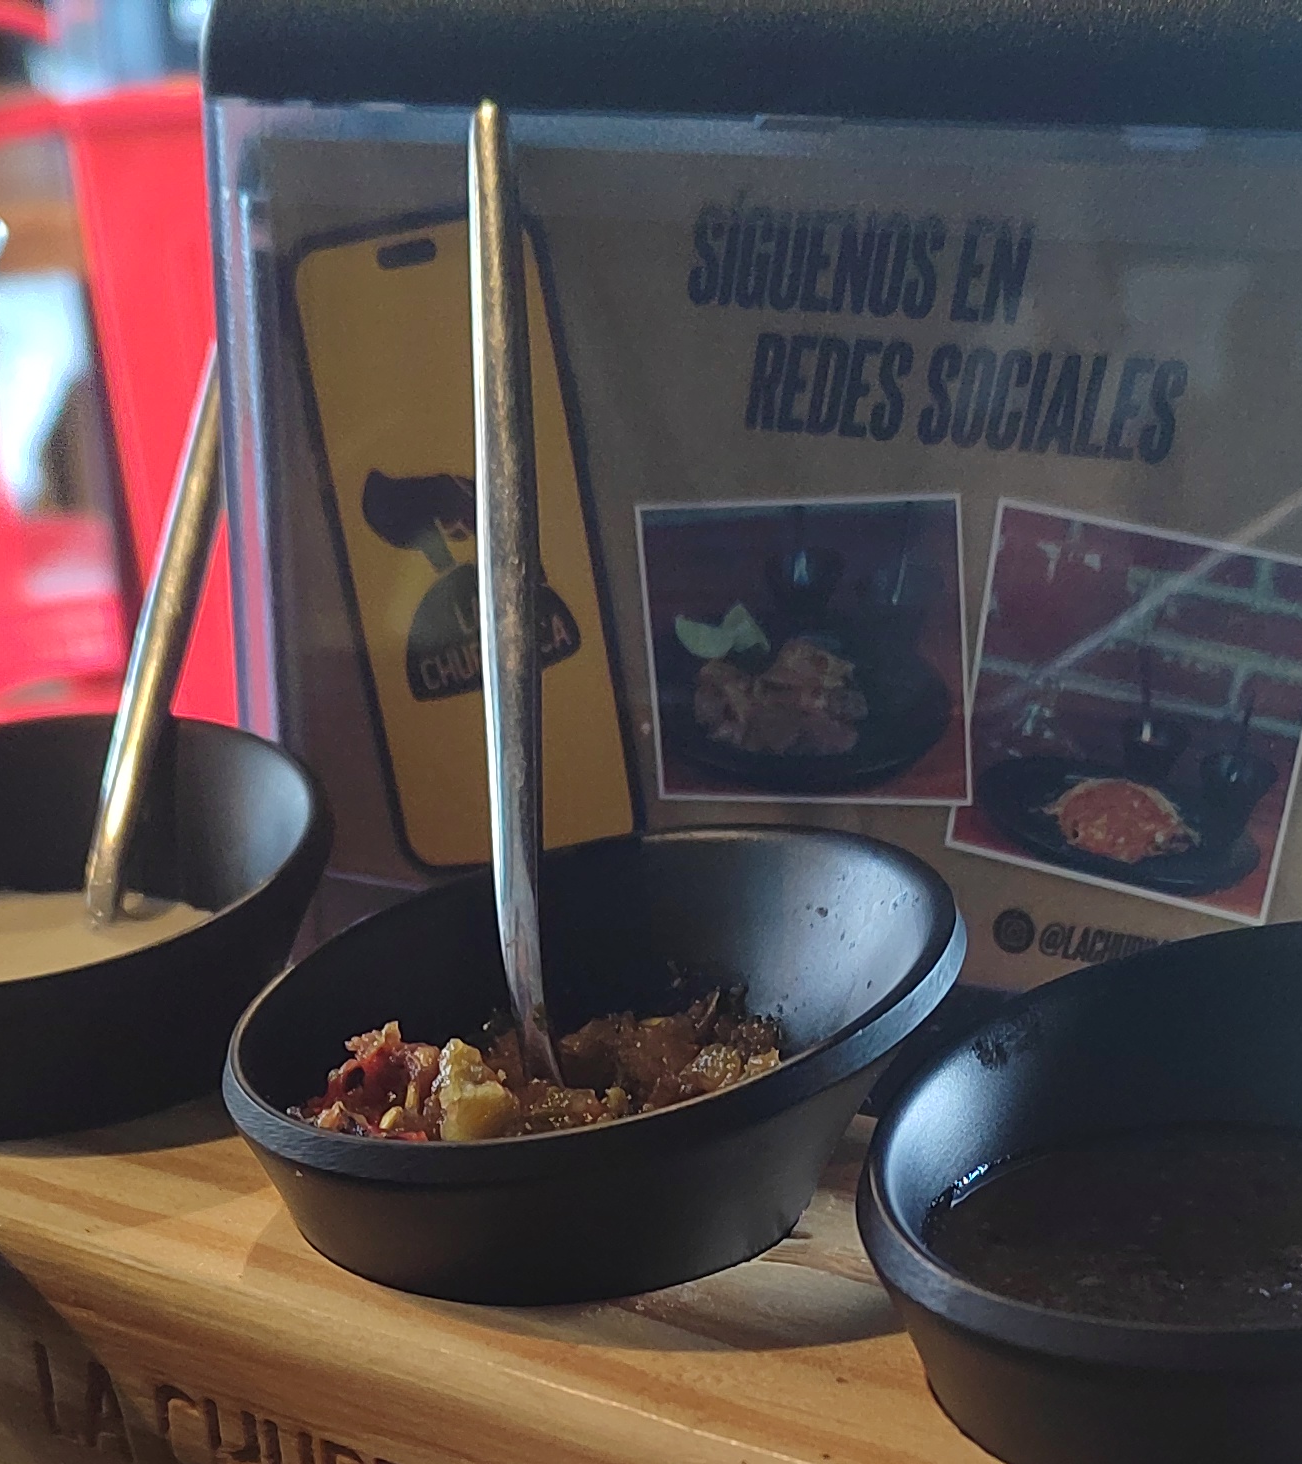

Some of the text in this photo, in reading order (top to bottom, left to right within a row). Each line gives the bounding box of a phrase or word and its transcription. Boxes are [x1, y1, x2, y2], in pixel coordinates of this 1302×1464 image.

[949, 212, 1035, 325] EN
[744, 332, 1189, 466] REDES SOCIALES
[33, 1340, 135, 1463] LA
